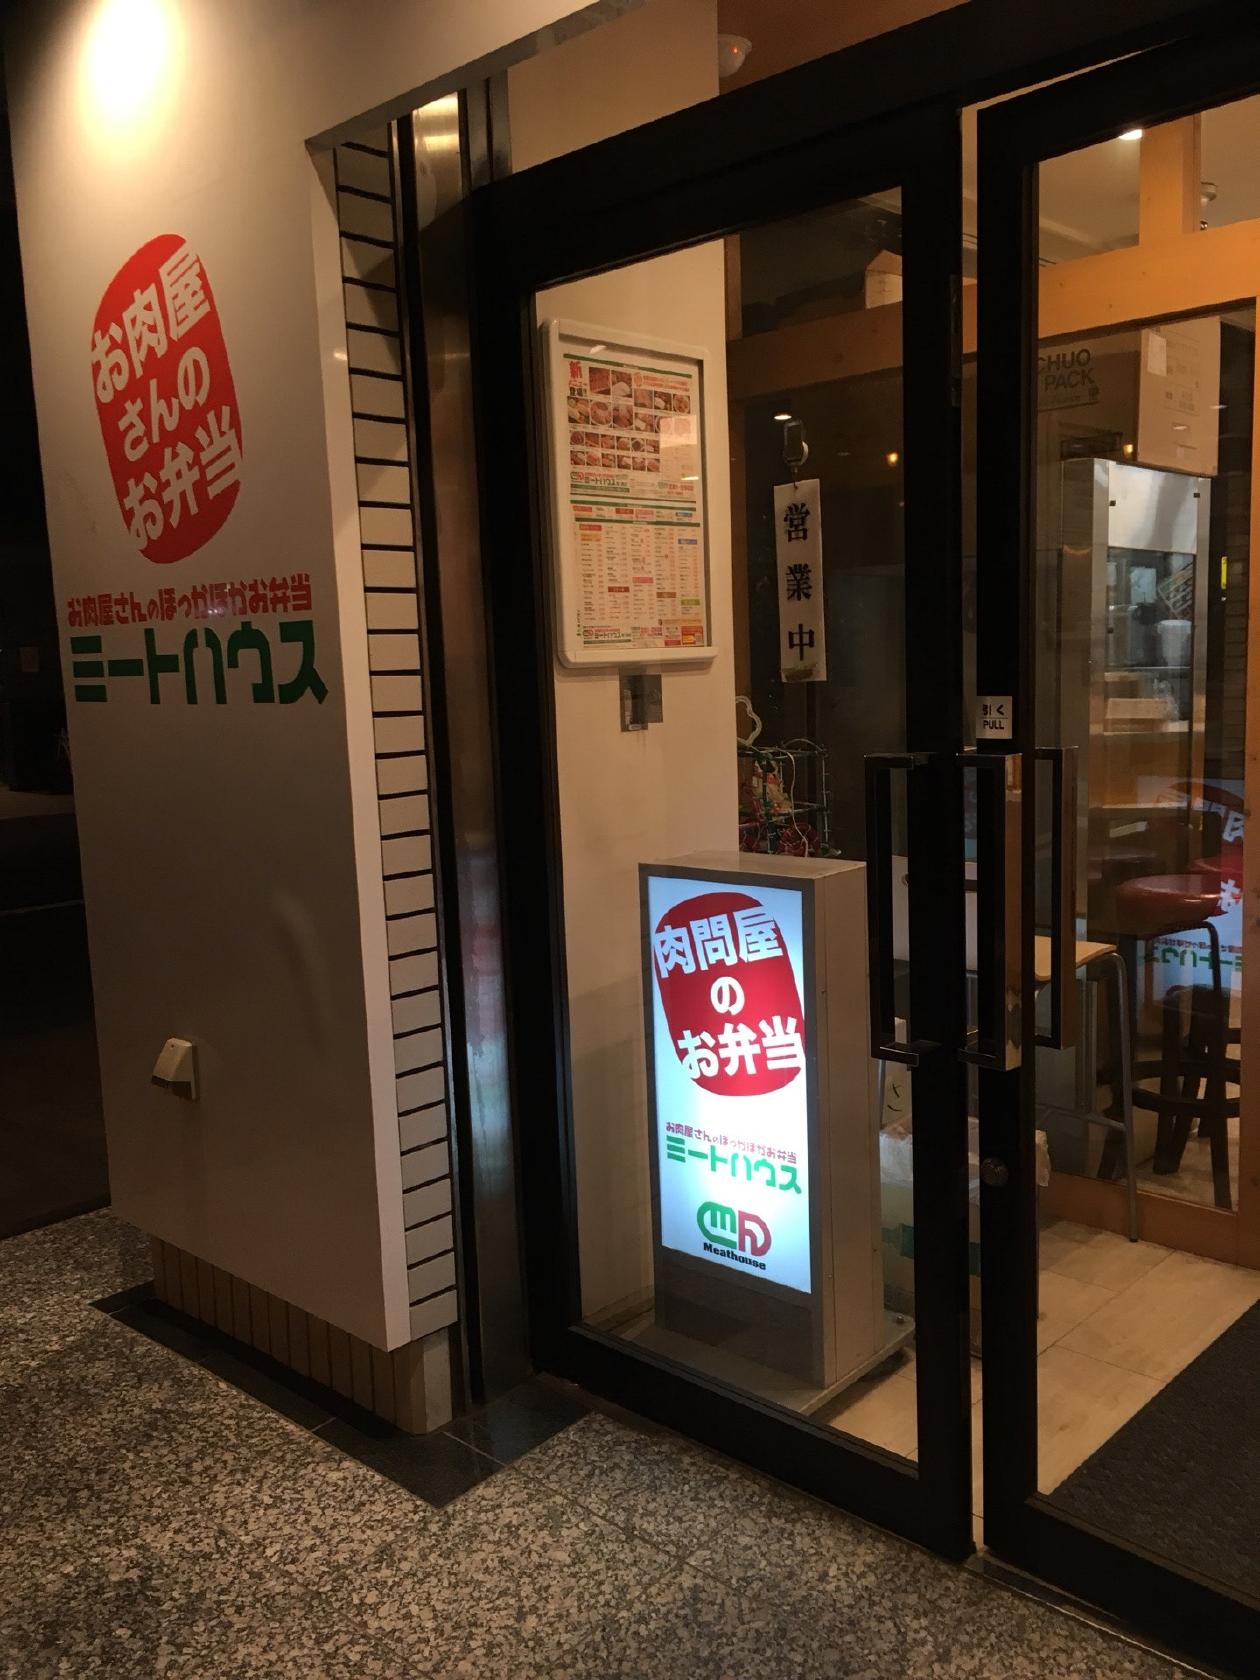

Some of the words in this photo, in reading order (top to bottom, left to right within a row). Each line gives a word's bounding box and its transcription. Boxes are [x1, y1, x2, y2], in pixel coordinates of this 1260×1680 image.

[91, 247, 212, 404] お肉屋
[117, 346, 210, 462] さんの
[1044, 368, 1095, 393] PACK
[124, 404, 243, 551] お弁当
[783, 502, 815, 661] 営業中
[70, 620, 328, 705] ミートハウス
[982, 703, 1005, 716] 引く
[983, 719, 1005, 730] PULL
[653, 905, 784, 978] 肉問屋
[710, 976, 746, 1016] の
[676, 1015, 804, 1081] お弁当
[666, 1121, 797, 1165] お肉屋さんのほっかほかお弁当
[666, 1134, 802, 1194] ミートハウス
[703, 1242, 767, 1271] Meathouse
